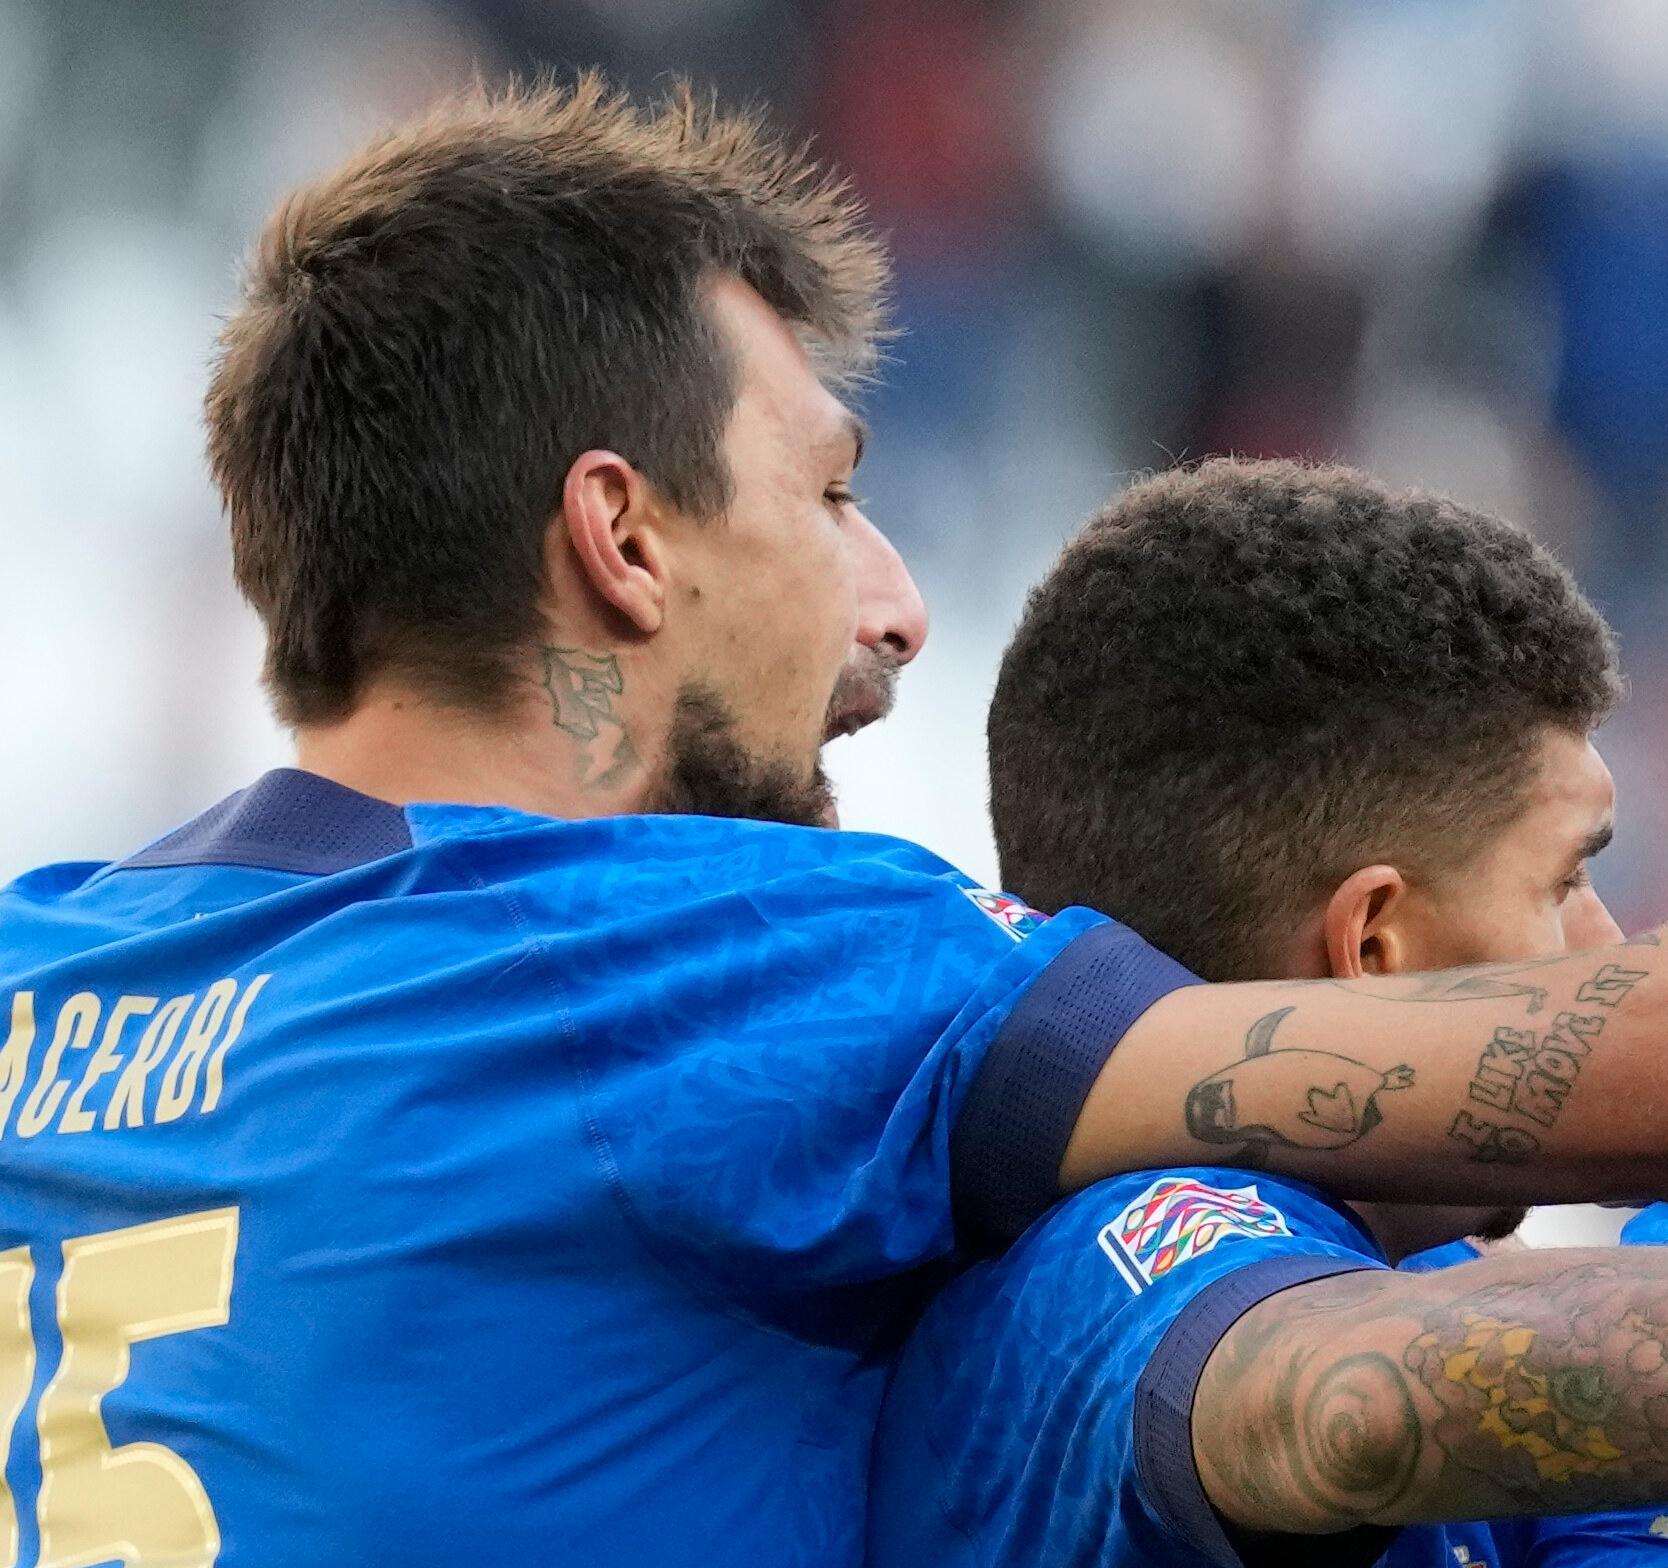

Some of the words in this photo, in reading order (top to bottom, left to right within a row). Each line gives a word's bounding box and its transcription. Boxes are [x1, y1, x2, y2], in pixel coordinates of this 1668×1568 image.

[1468, 1026, 1535, 1112] LIKE
[1514, 1011, 1606, 1128] MOVE
[1575, 964, 1649, 1007] IT
